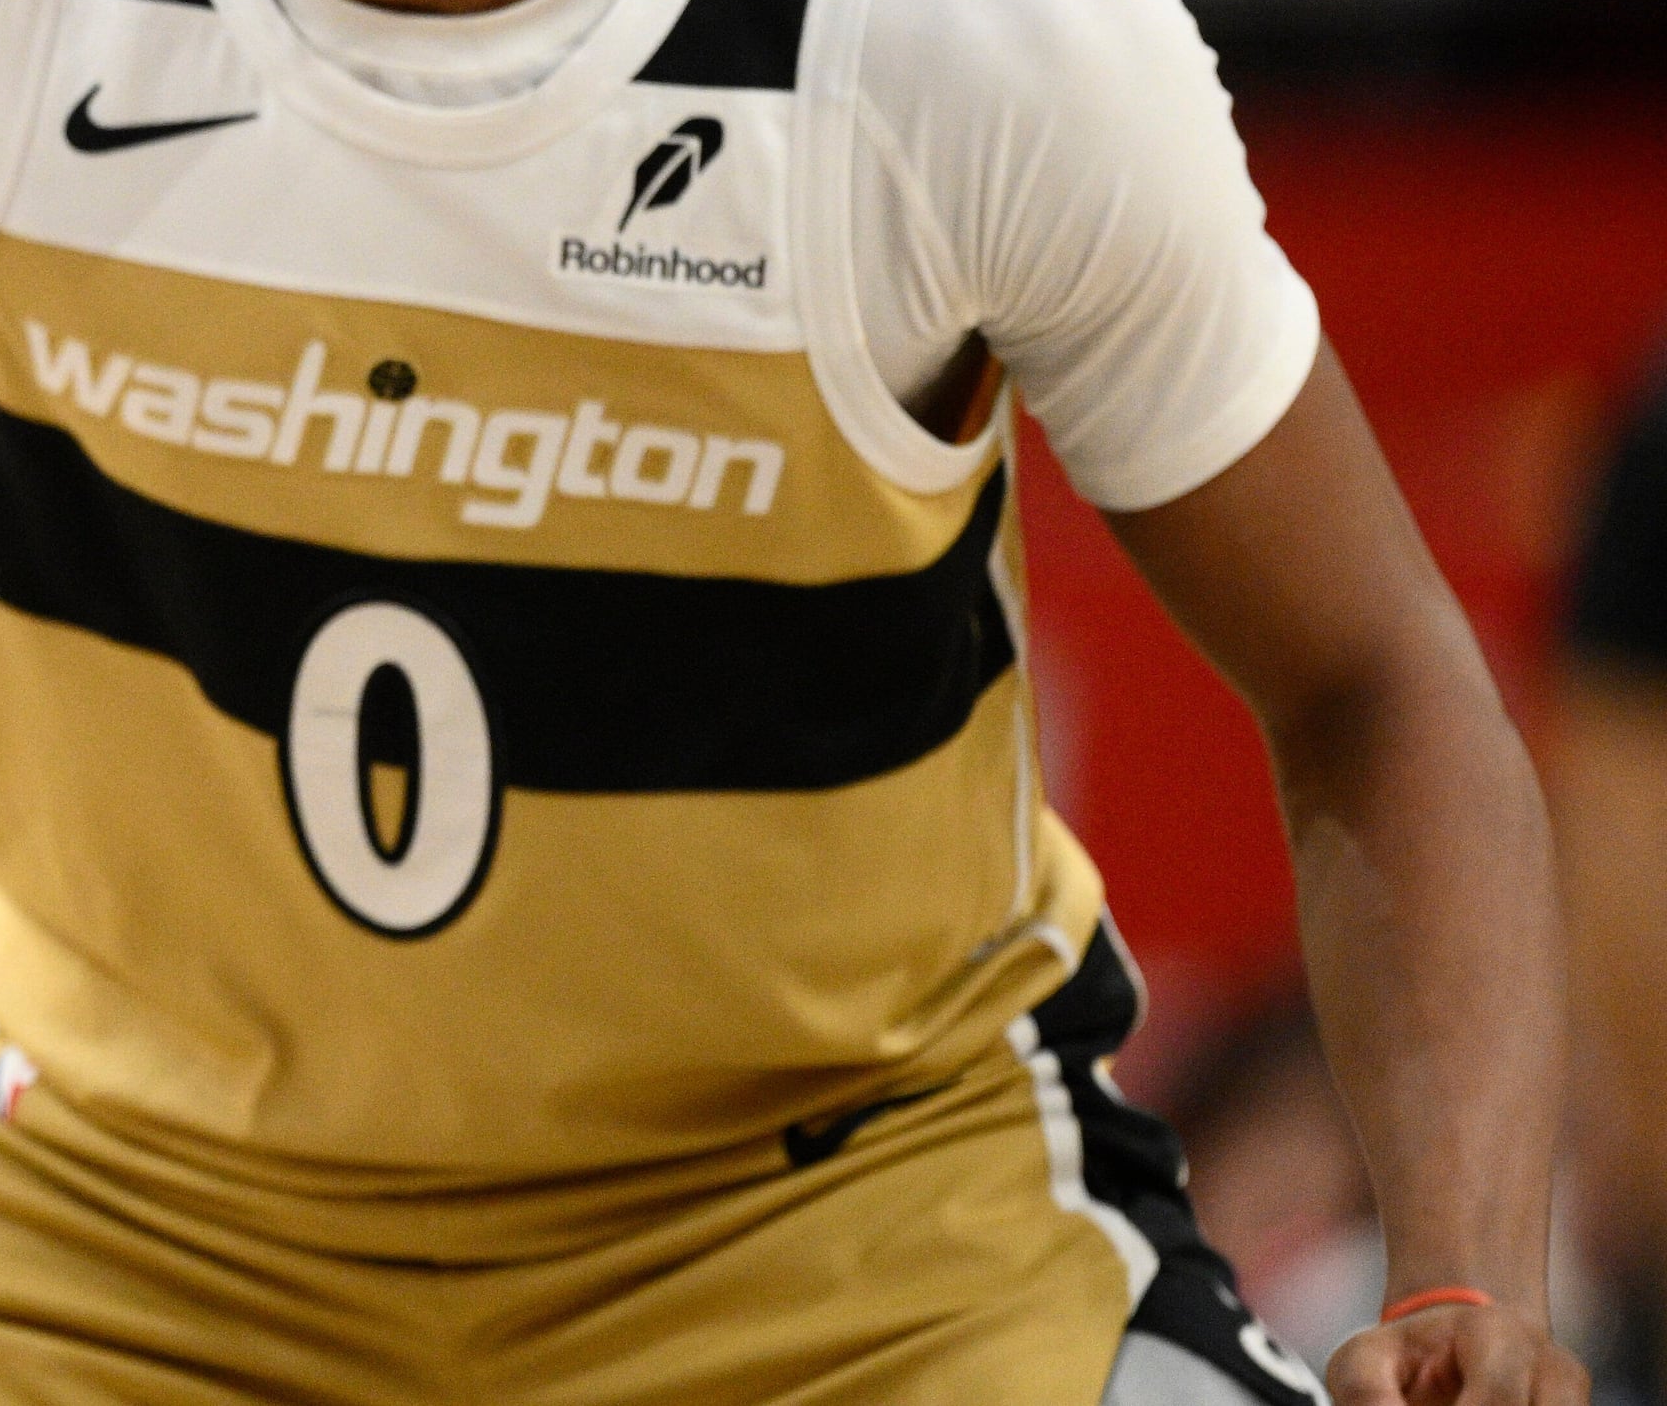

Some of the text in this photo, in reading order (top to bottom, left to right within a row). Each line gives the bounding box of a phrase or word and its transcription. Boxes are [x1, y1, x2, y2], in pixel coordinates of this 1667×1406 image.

[559, 237, 767, 289] Robinhood
[23, 324, 783, 527] washington
[279, 597, 505, 940] 0
